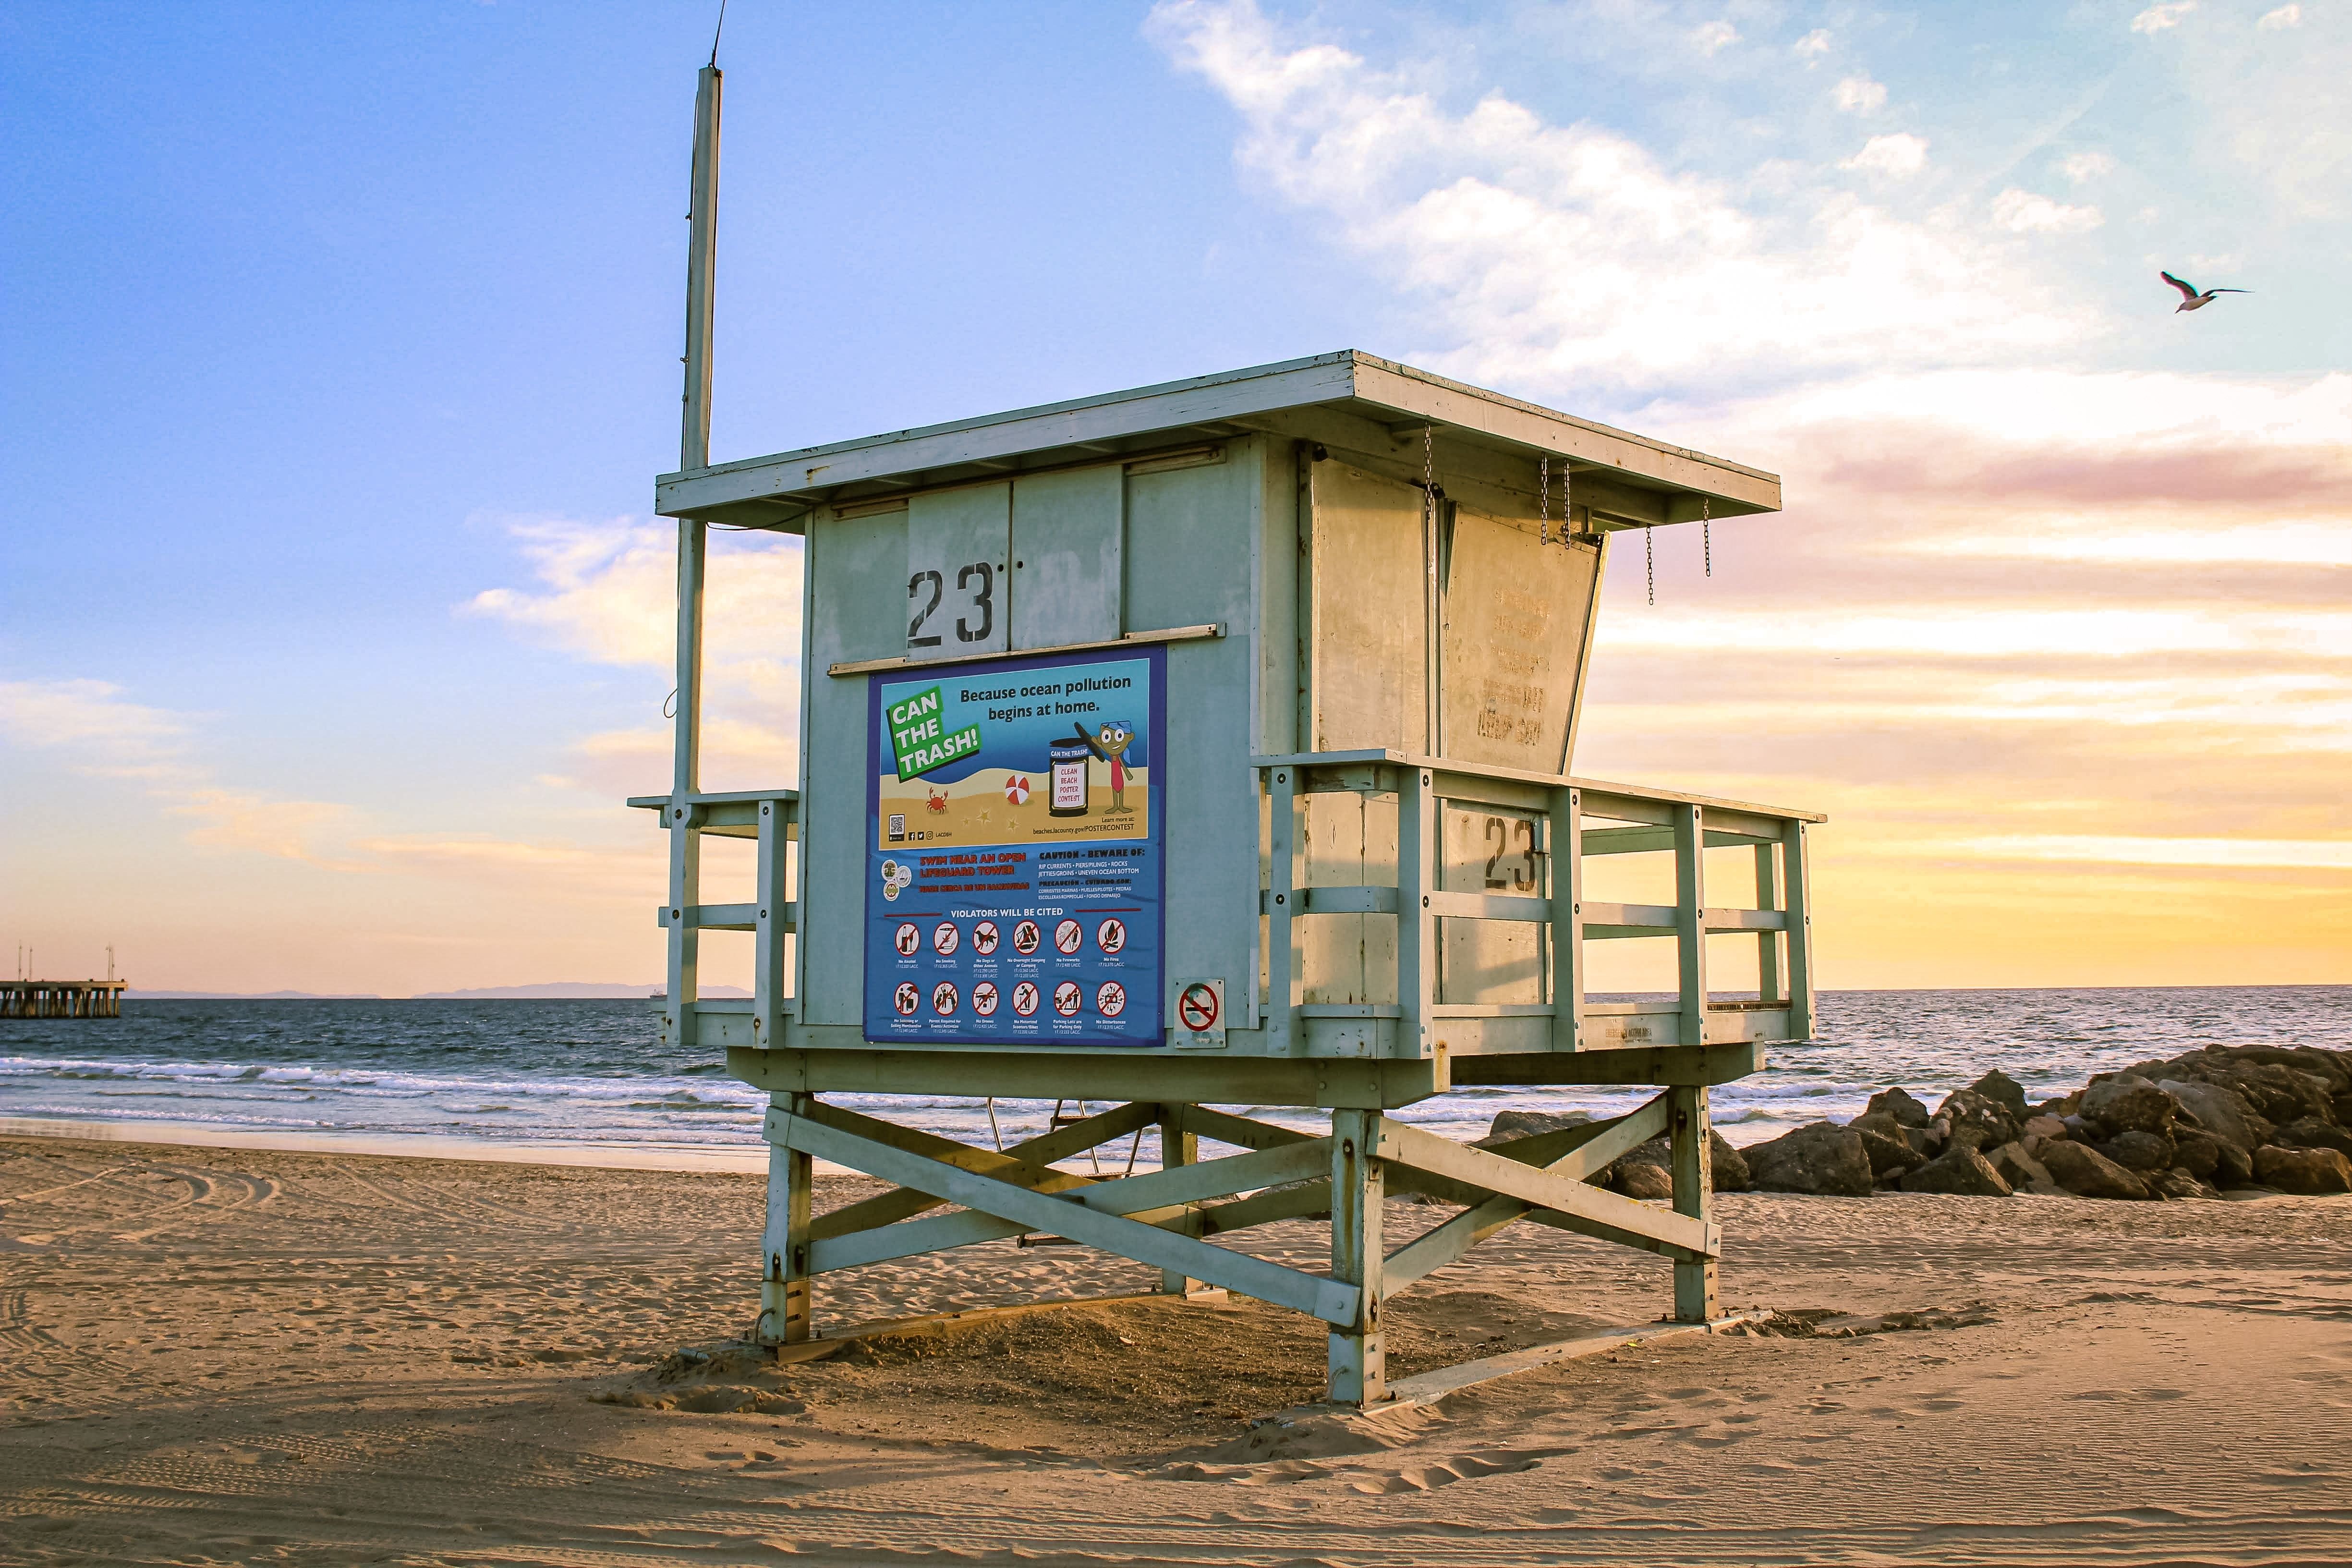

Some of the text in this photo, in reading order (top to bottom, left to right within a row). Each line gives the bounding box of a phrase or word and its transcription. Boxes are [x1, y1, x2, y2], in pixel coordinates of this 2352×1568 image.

[907, 561, 993, 648] 23
[960, 676, 1131, 702] Because ocean pollution
[892, 692, 938, 724] CAN
[988, 700, 1100, 722] begins at home.
[896, 717, 939, 749] THE
[899, 728, 978, 773] TRASH!
[920, 852, 1026, 866] SWIM NEAR AN OPEN
[1039, 851, 1079, 860] CAUTION
[1088, 849, 1128, 858] BEWARE
[1130, 848, 1145, 856] OF:
[1486, 817, 1535, 892] 23
[920, 865, 1015, 878] LIFEGUARD TOWER
[951, 909, 997, 918] VIOLATORS
[999, 909, 1021, 917] WILL
[1037, 908, 1063, 916] CITED
